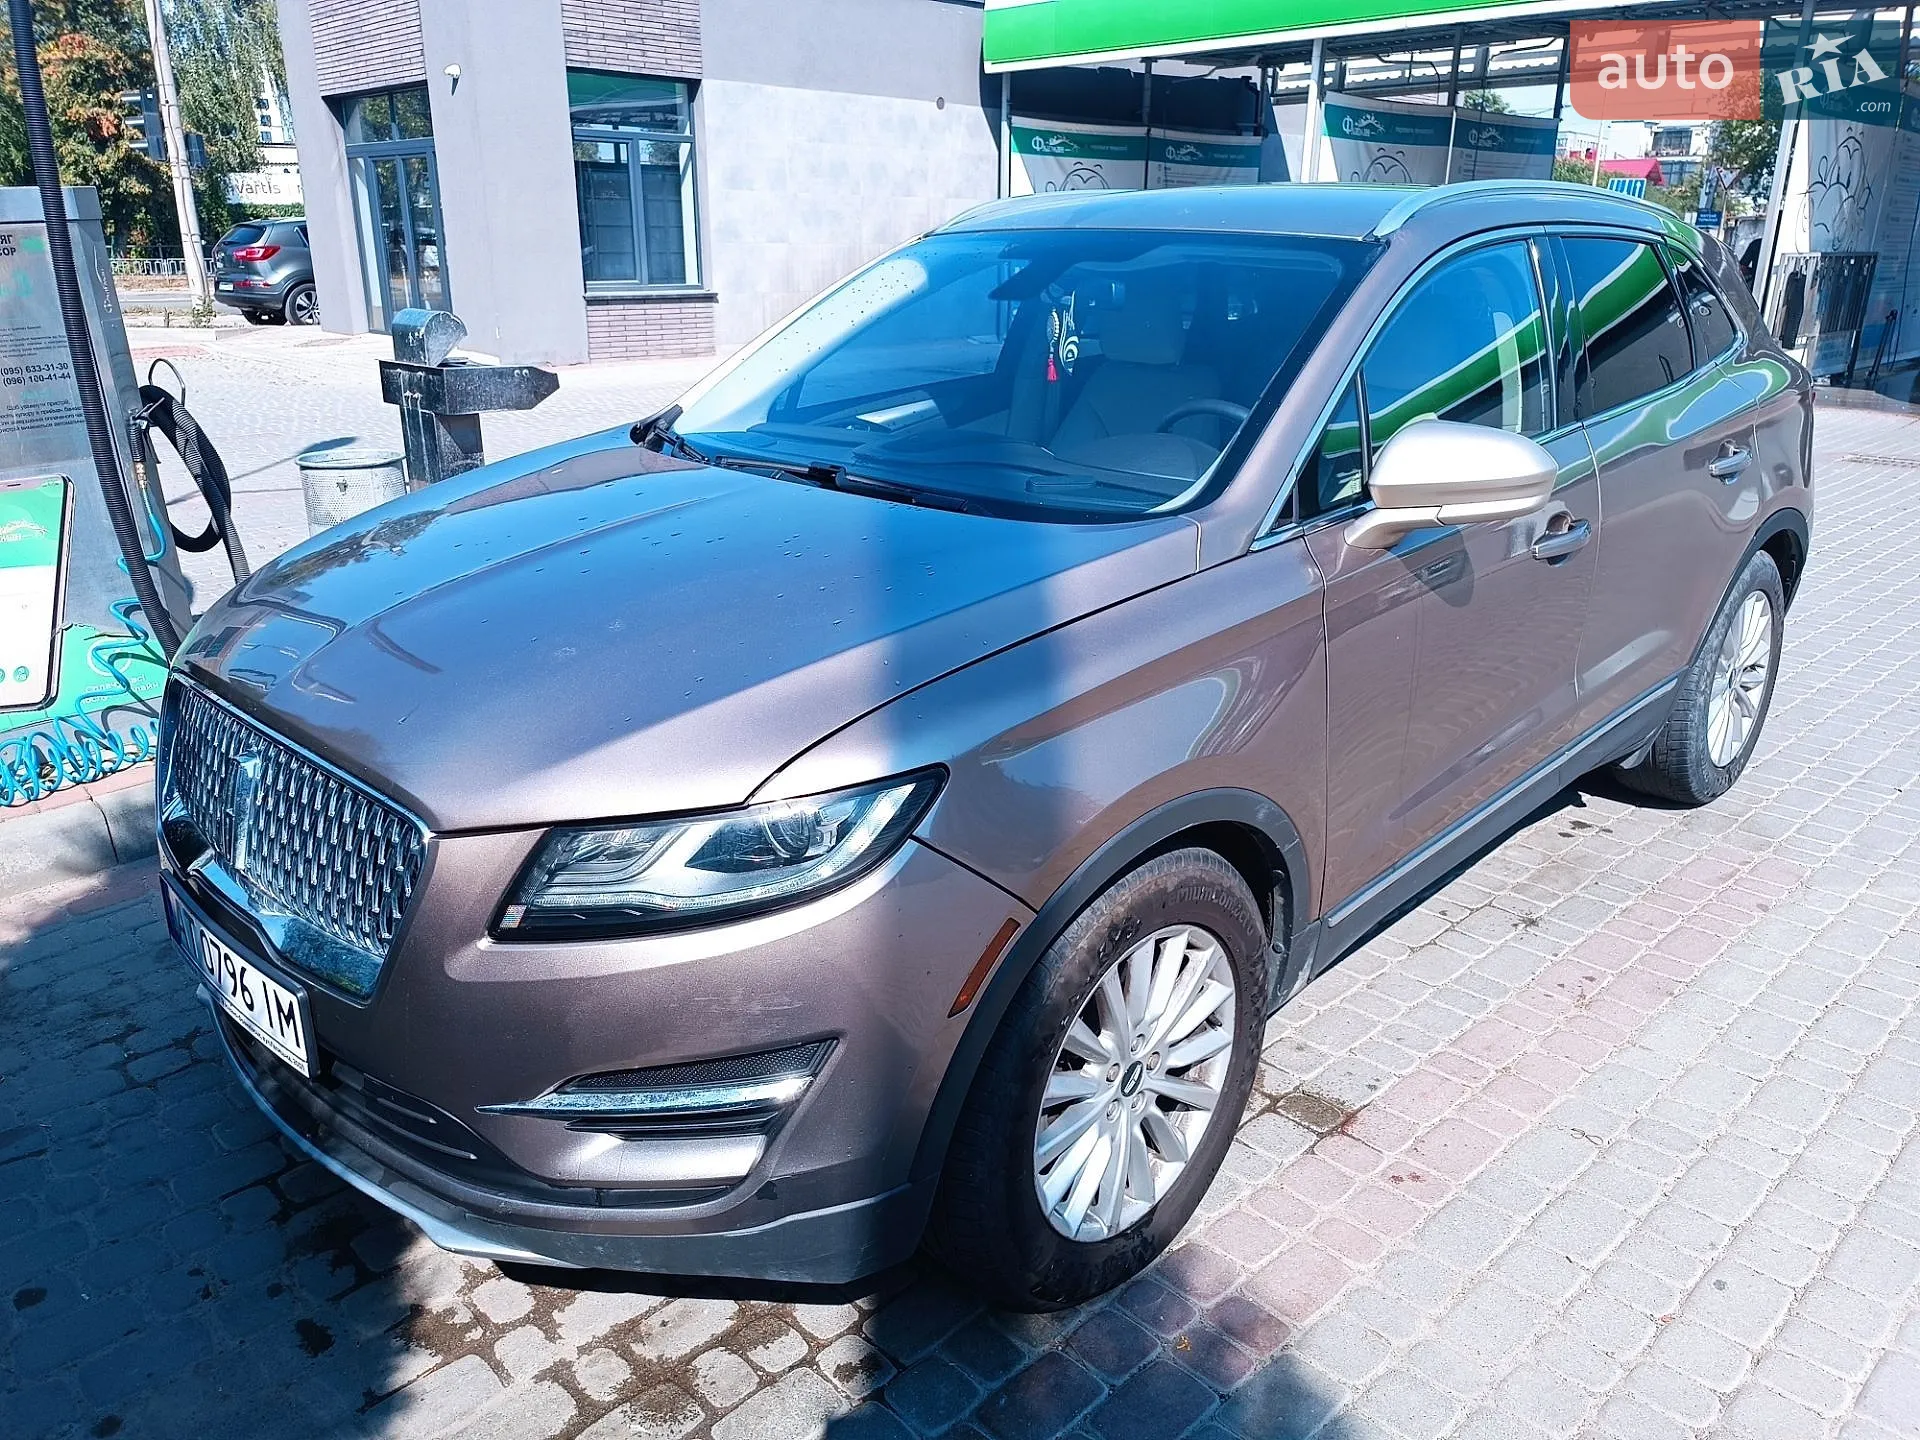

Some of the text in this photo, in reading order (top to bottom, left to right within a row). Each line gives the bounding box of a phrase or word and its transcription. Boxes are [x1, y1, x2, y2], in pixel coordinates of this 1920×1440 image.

[25, 362, 69, 374] 633-31-30
[28, 372, 71, 383] 100-41-44
[200, 928, 255, 1012] 0796
[262, 980, 301, 1049] IM
